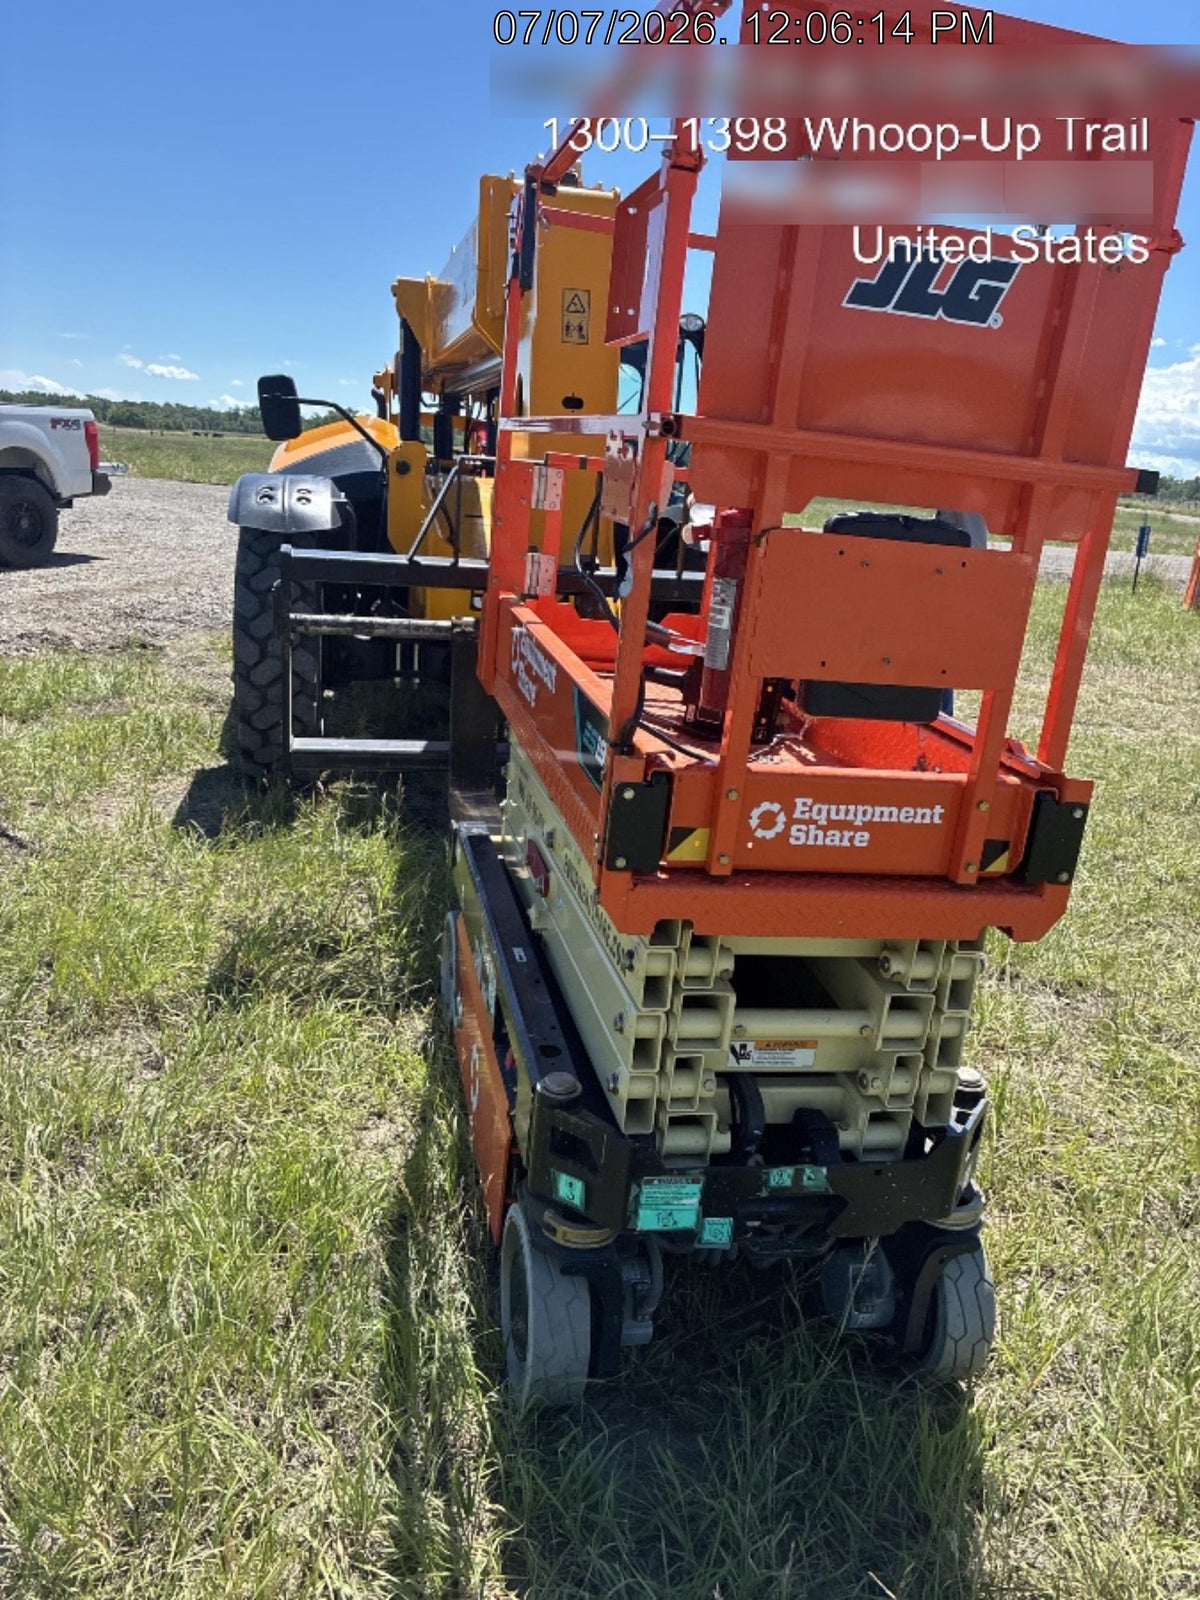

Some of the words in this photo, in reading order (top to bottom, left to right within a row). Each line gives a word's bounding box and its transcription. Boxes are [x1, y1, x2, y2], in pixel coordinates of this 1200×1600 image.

[841, 242, 1023, 328] JLG
[792, 797, 945, 826] Equipment
[788, 824, 870, 848] Share
